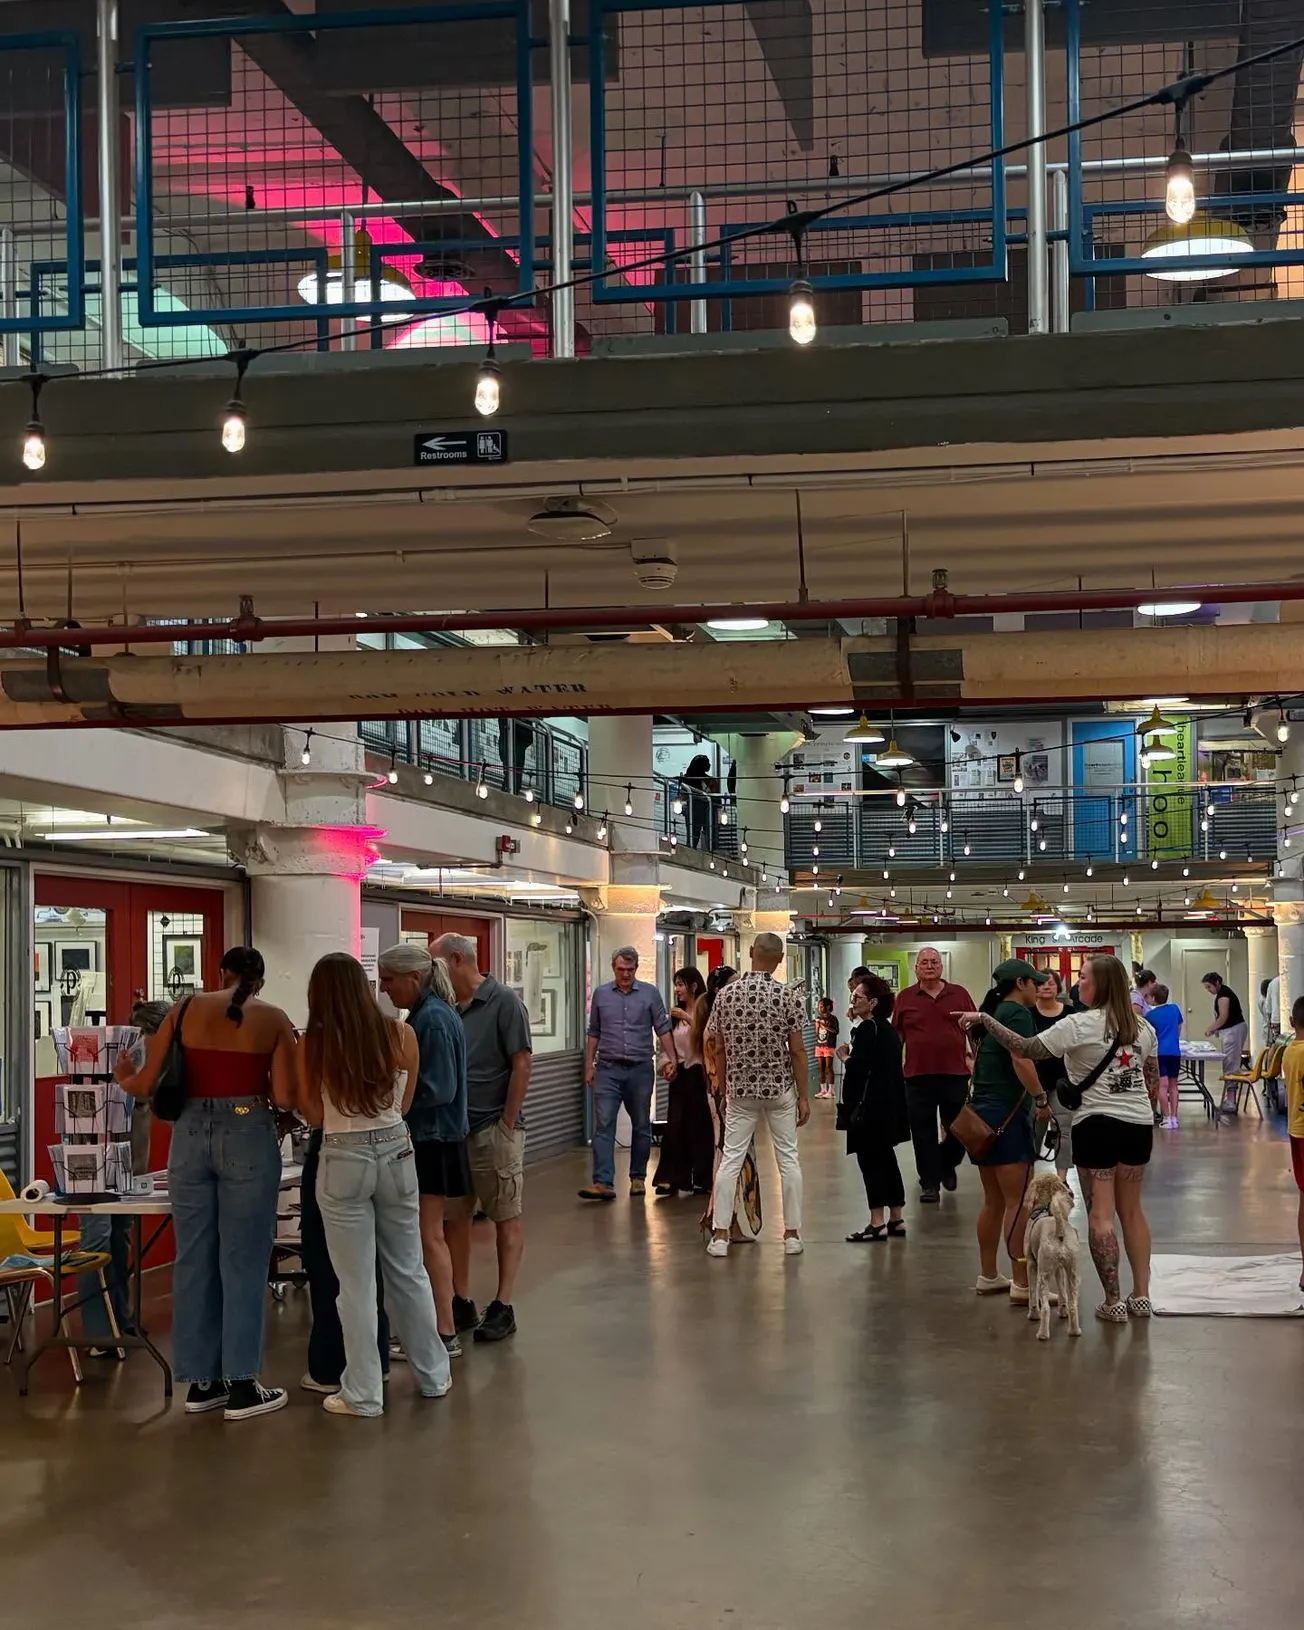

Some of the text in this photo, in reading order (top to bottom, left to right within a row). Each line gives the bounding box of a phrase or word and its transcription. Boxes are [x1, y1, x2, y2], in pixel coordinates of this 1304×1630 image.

[420, 451, 467, 460] Restrooms
[495, 683, 587, 695] WATER
[1176, 724, 1187, 805] heartleaue
[1025, 935, 1046, 945] King
